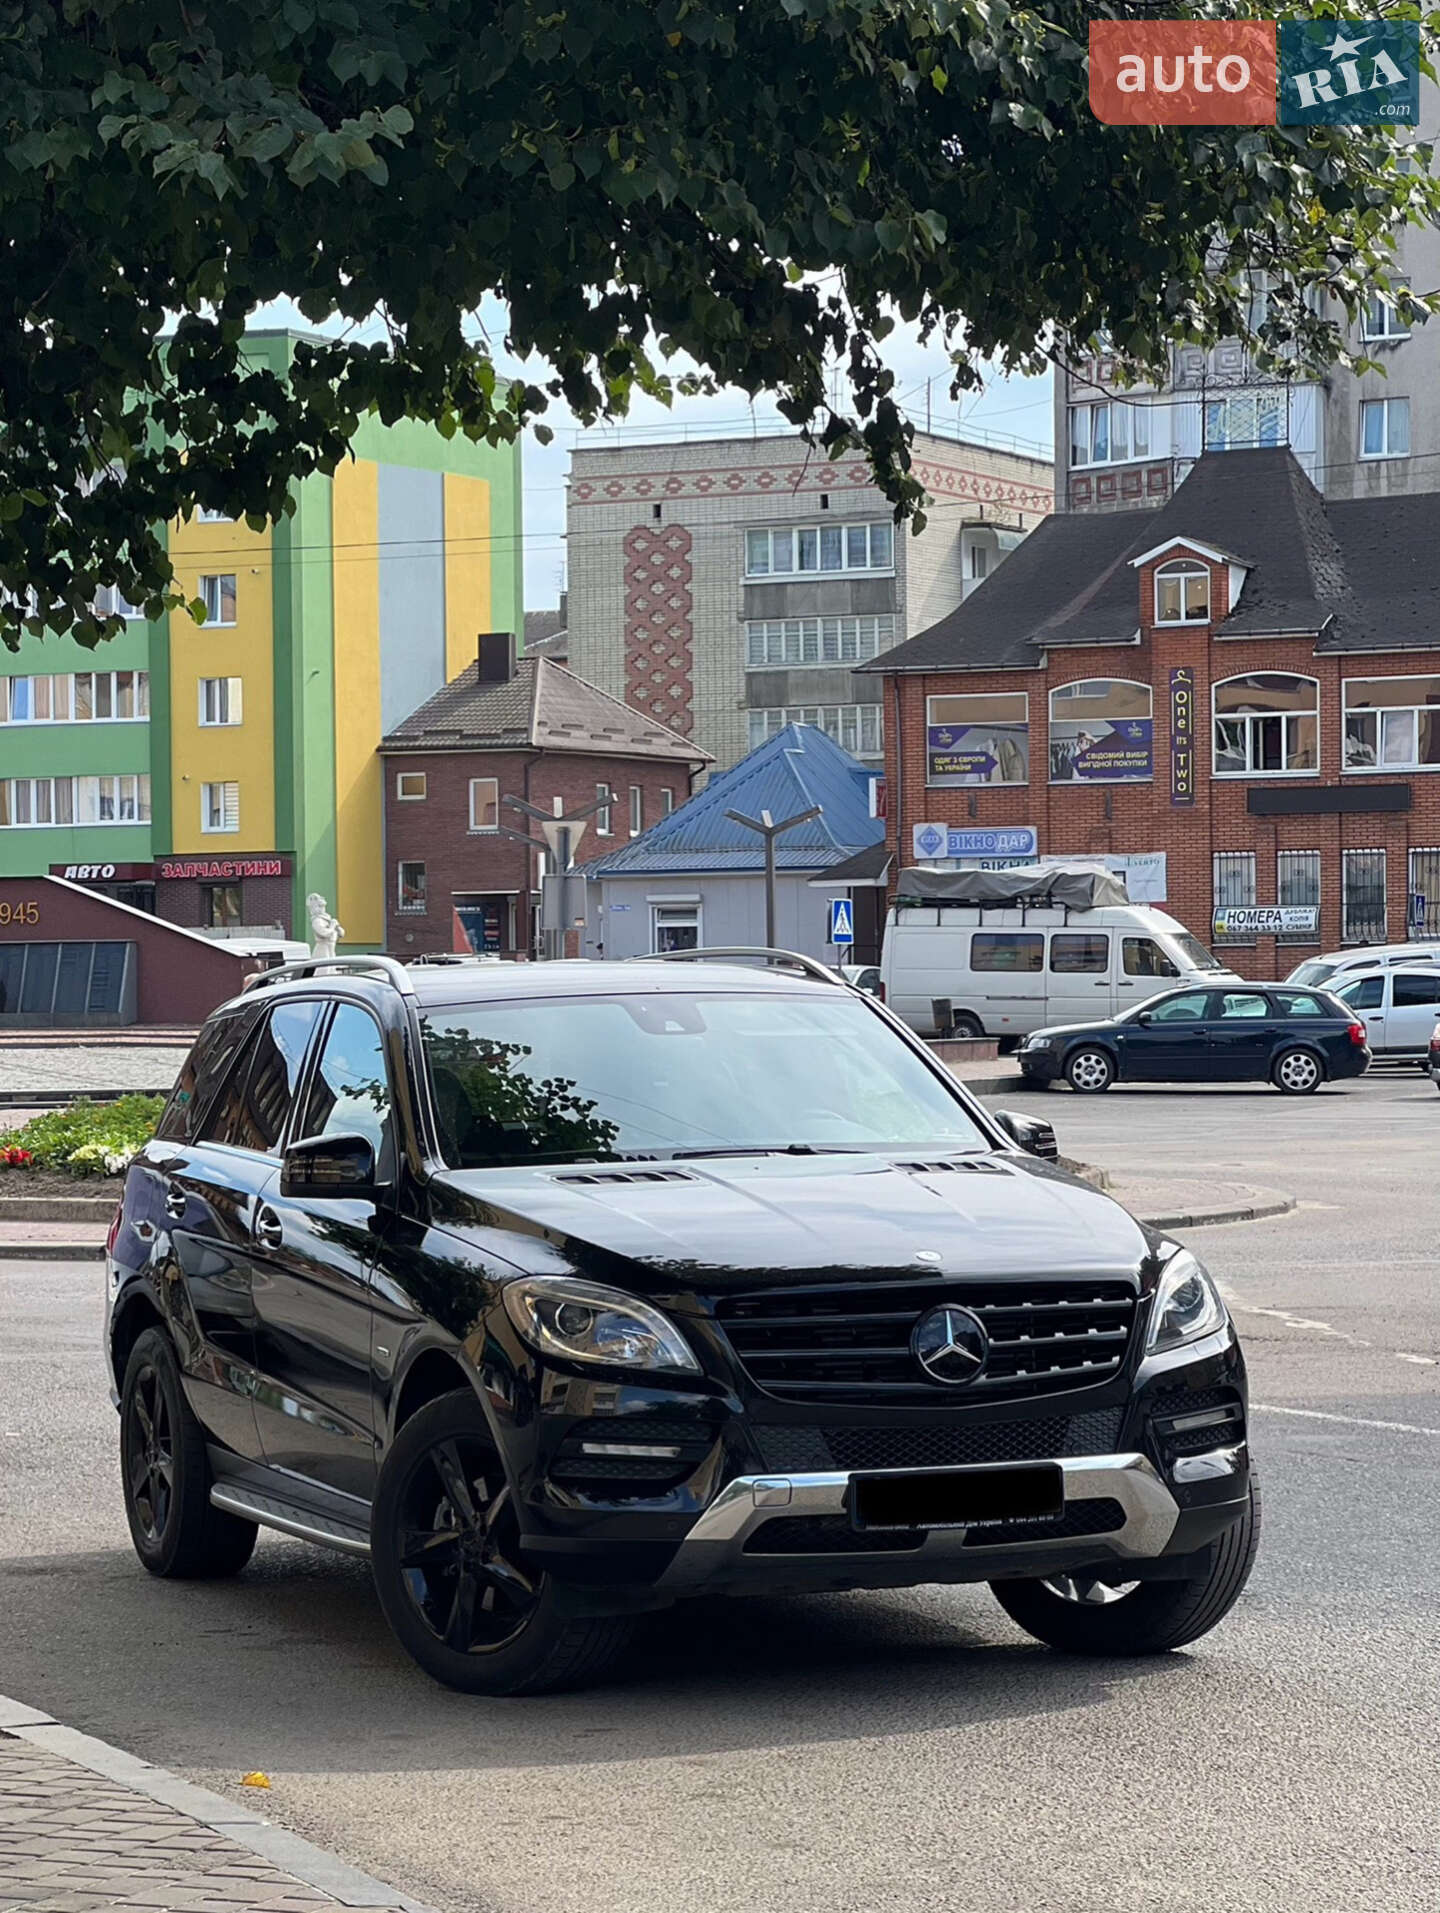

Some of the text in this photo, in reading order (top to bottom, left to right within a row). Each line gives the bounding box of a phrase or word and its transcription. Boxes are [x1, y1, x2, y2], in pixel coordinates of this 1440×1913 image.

[1175, 690, 1188, 728] One
[1176, 753, 1188, 791] Two
[64, 860, 282, 879] АВТО ЗАПЧАСТИНИ
[1227, 910, 1282, 924] НОМЕРА
